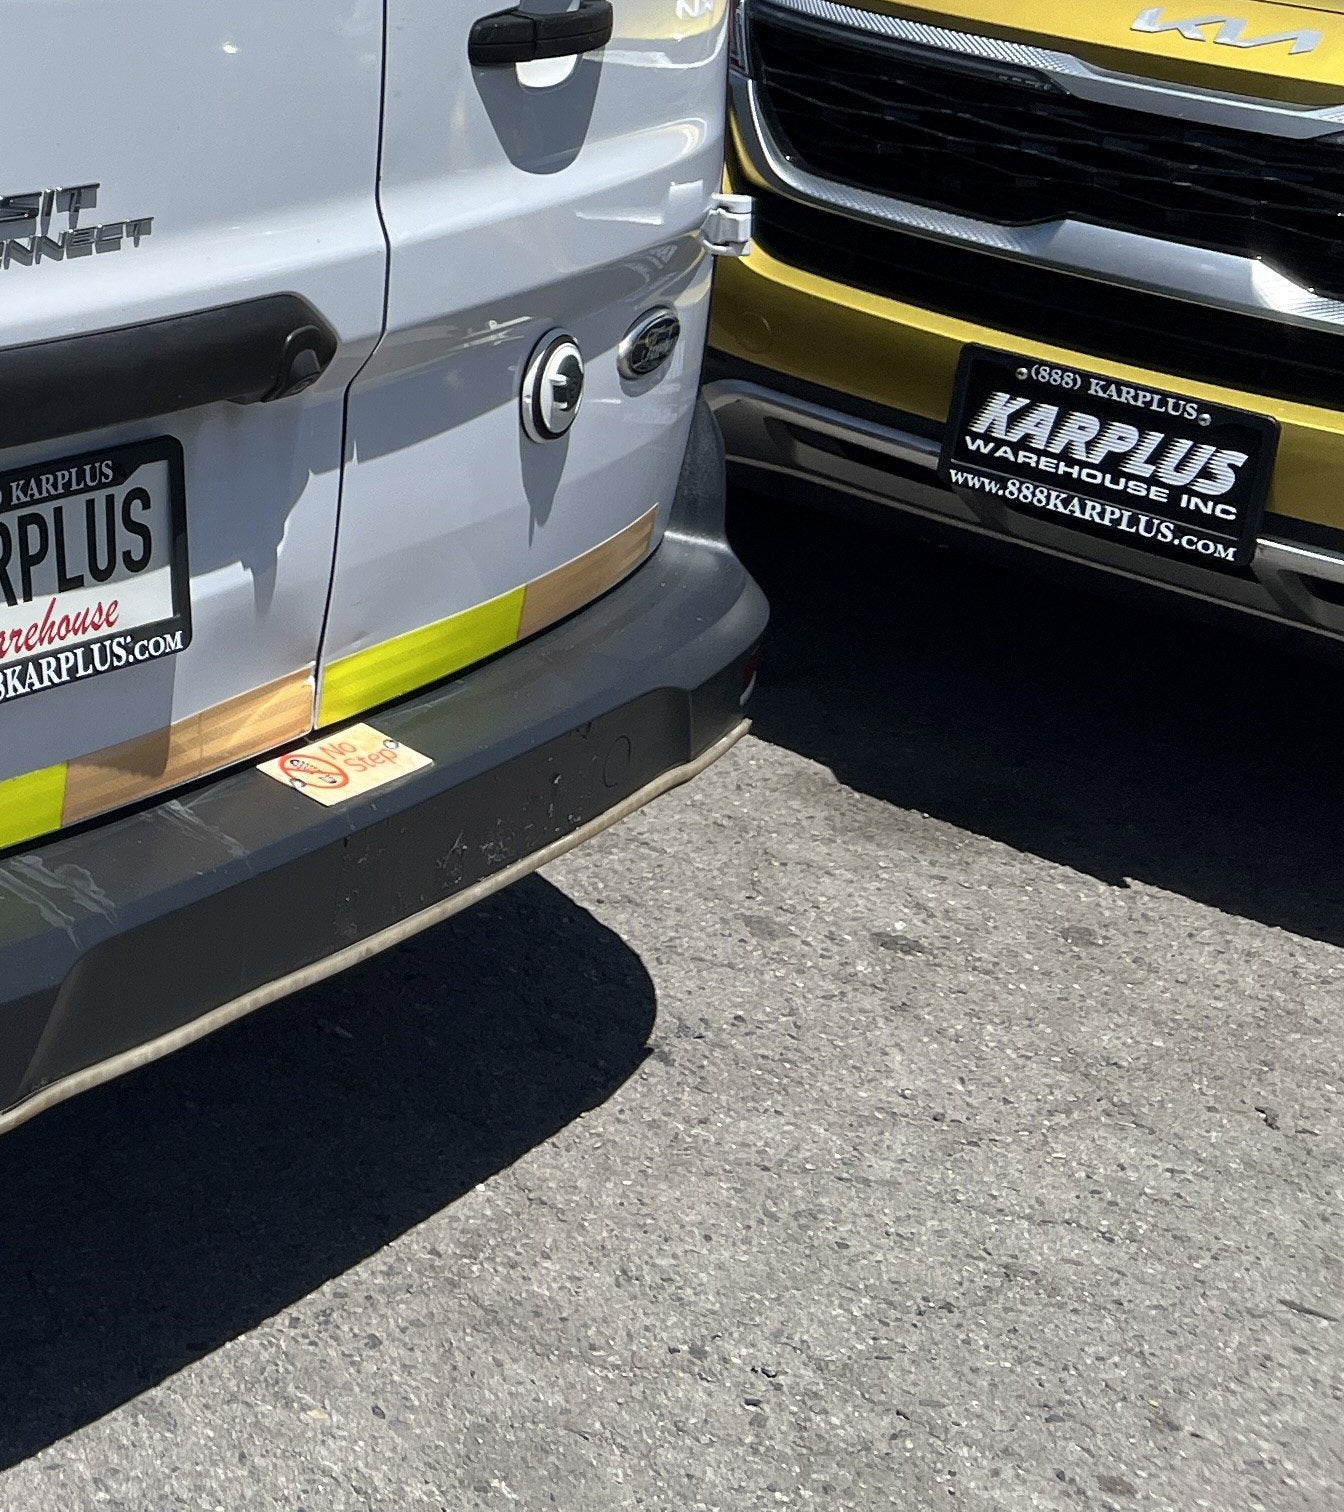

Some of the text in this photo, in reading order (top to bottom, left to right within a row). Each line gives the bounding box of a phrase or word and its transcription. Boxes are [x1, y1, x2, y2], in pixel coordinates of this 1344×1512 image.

[1031, 364, 1199, 420] (888) KARPLUS
[967, 391, 1249, 496] KARPLUS
[10, 460, 113, 505] KARPLUS
[965, 436, 1237, 521] WAREHOUSE INC
[319, 740, 357, 760] No
[344, 747, 398, 773] Step
